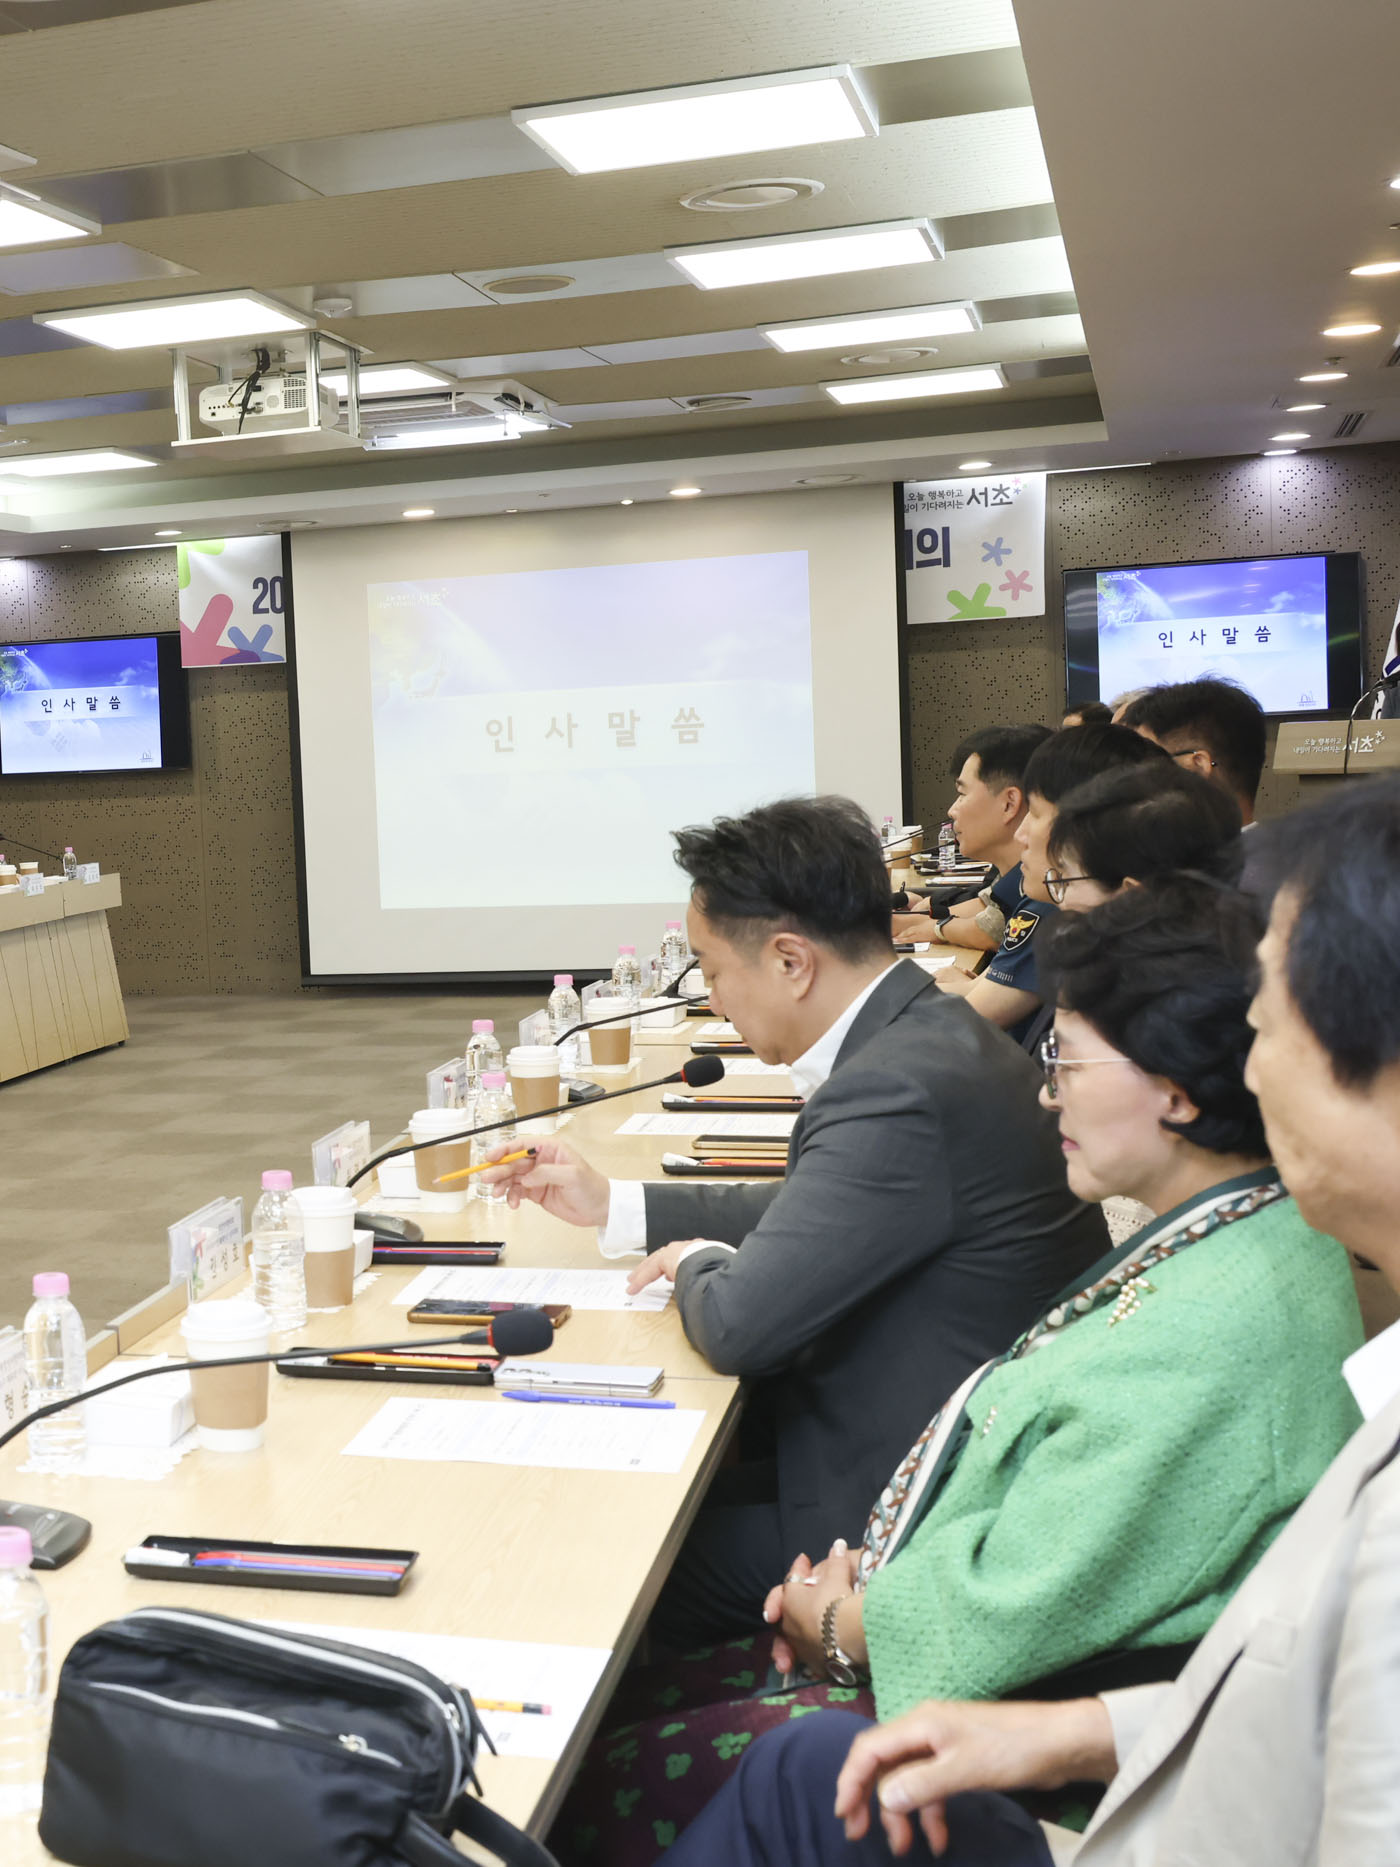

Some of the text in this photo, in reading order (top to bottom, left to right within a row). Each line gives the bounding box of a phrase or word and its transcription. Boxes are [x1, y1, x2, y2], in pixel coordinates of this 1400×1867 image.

[907, 489, 964, 502] 오늘 행복하고
[921, 498, 964, 511] 기다려지는
[966, 484, 1013, 508] 서초
[904, 526, 951, 571] 의
[252, 575, 284, 614] 20
[1343, 736, 1374, 754] 서초
